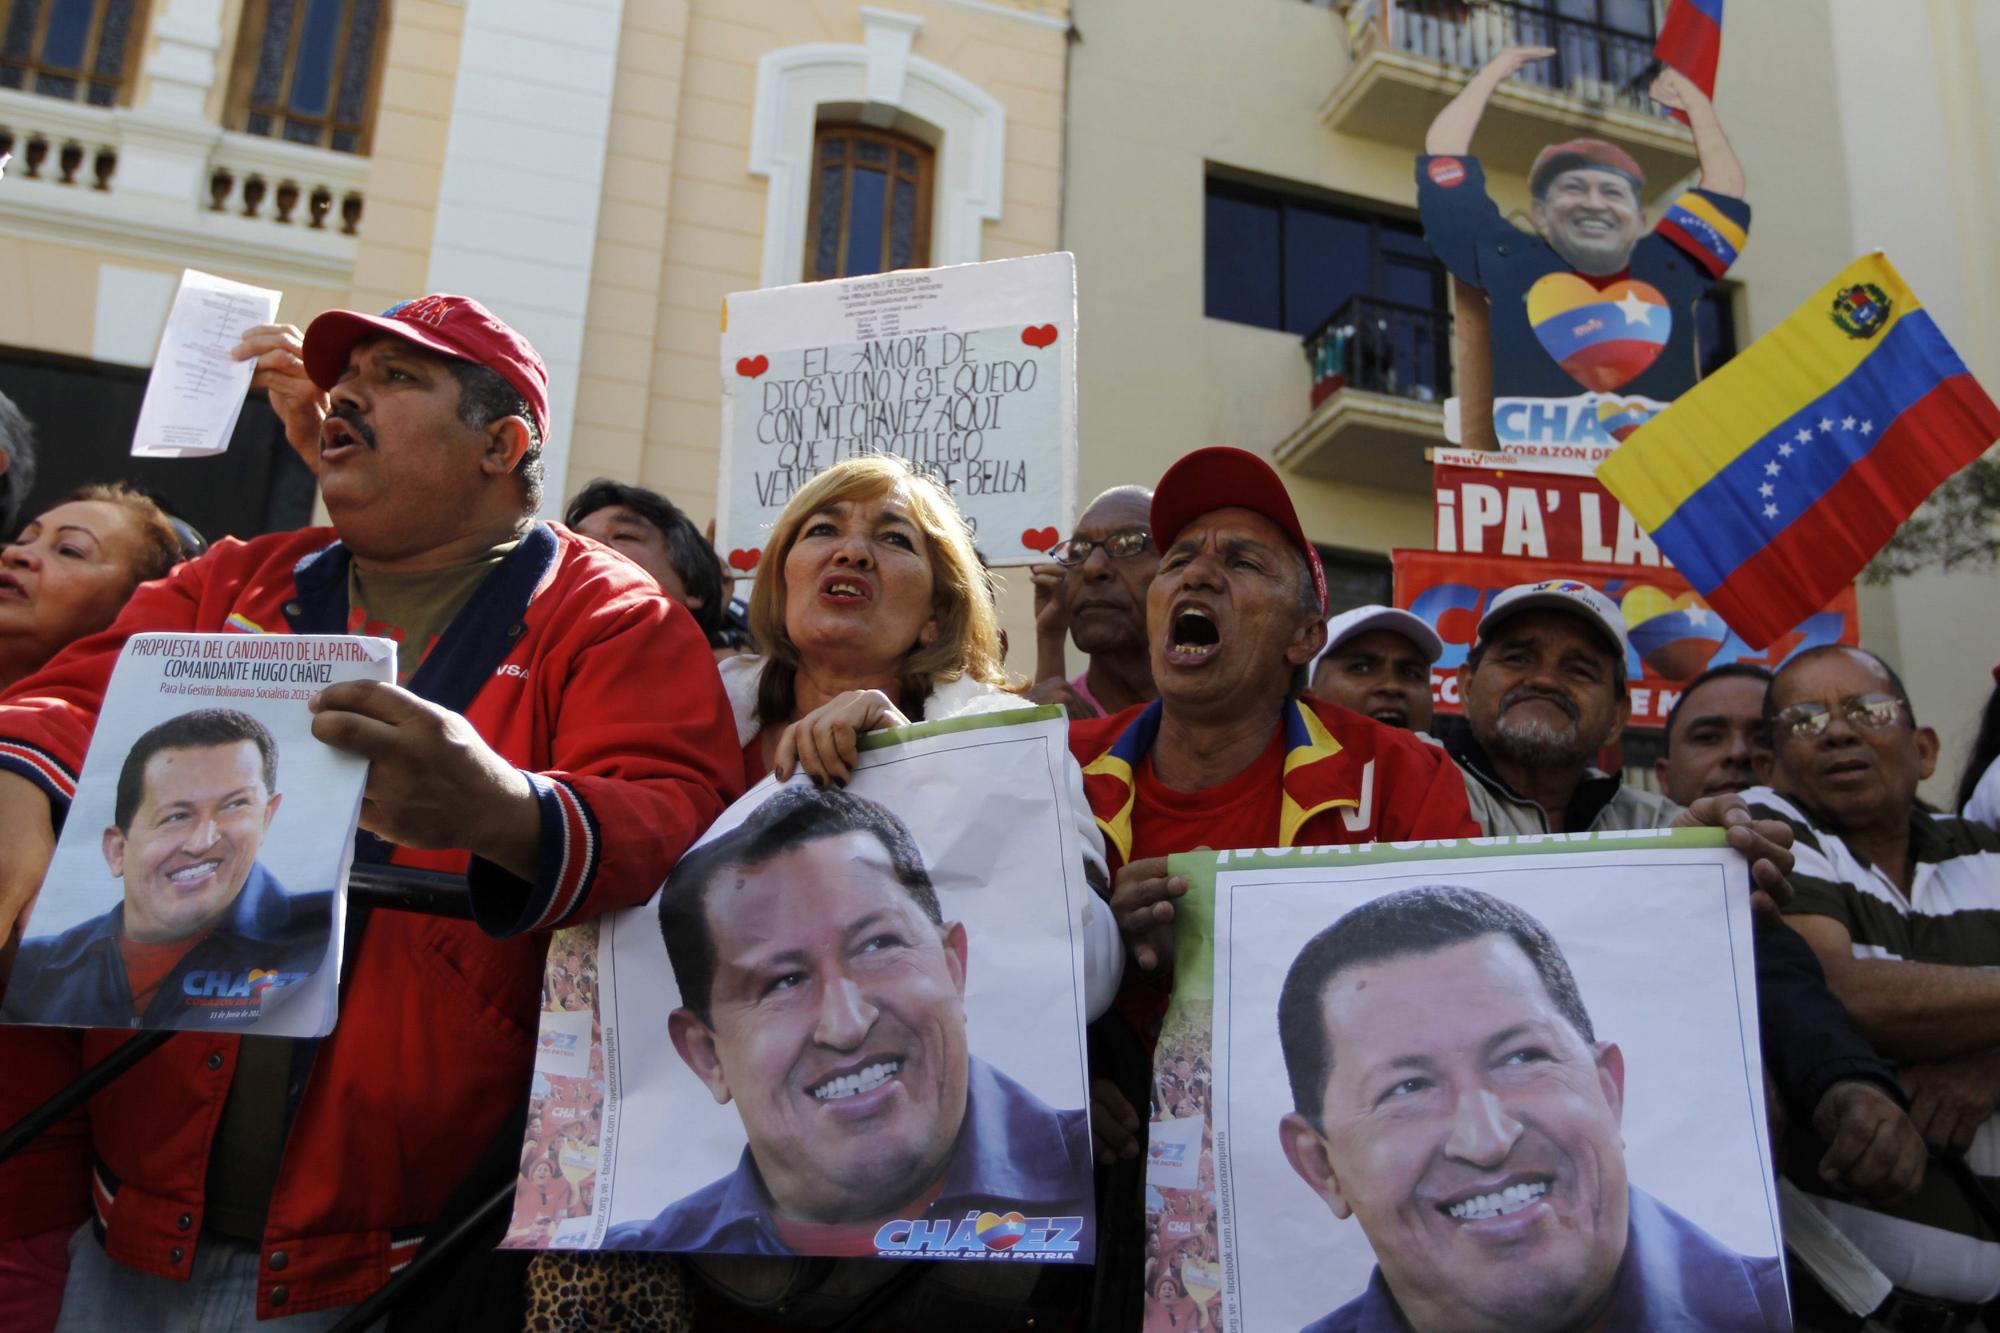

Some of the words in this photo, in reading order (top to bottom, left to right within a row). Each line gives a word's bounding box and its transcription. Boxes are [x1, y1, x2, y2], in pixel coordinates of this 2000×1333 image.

[804, 346, 842, 377] EL
[850, 335, 927, 372] AMOR
[942, 330, 979, 365] DE
[763, 375, 826, 413] DIOS
[831, 369, 891, 405] VINO
[914, 366, 948, 400] SE
[953, 359, 1038, 396] QUEDO
[757, 406, 803, 445] CON
[815, 404, 845, 440] MI
[850, 399, 932, 436] CHAVEZ
[933, 394, 1004, 432] AQUI
[1494, 397, 1612, 444] CHÁ
[778, 438, 823, 471] QUE
[966, 459, 1027, 496] BELLA
[1579, 491, 1676, 568] LA
[131, 638, 200, 659] PROPUESTA
[203, 639, 225, 659] DEL
[226, 640, 294, 662] CANDIDATO
[296, 641, 312, 661] DE
[312, 642, 327, 662] LA
[164, 659, 249, 681] COMANDANTE
[252, 662, 288, 683] HUGO
[290, 661, 333, 684] CHÁVEZ
[160, 683, 177, 695] Para
[178, 683, 186, 695] la
[187, 684, 215, 698] Gestión
[215, 685, 256, 698] Bolivariana
[255, 687, 290, 700] Socialista
[962, 1251, 987, 1259] DE
[989, 1251, 1010, 1259] MI
[1012, 1251, 1075, 1260] PATRIA
